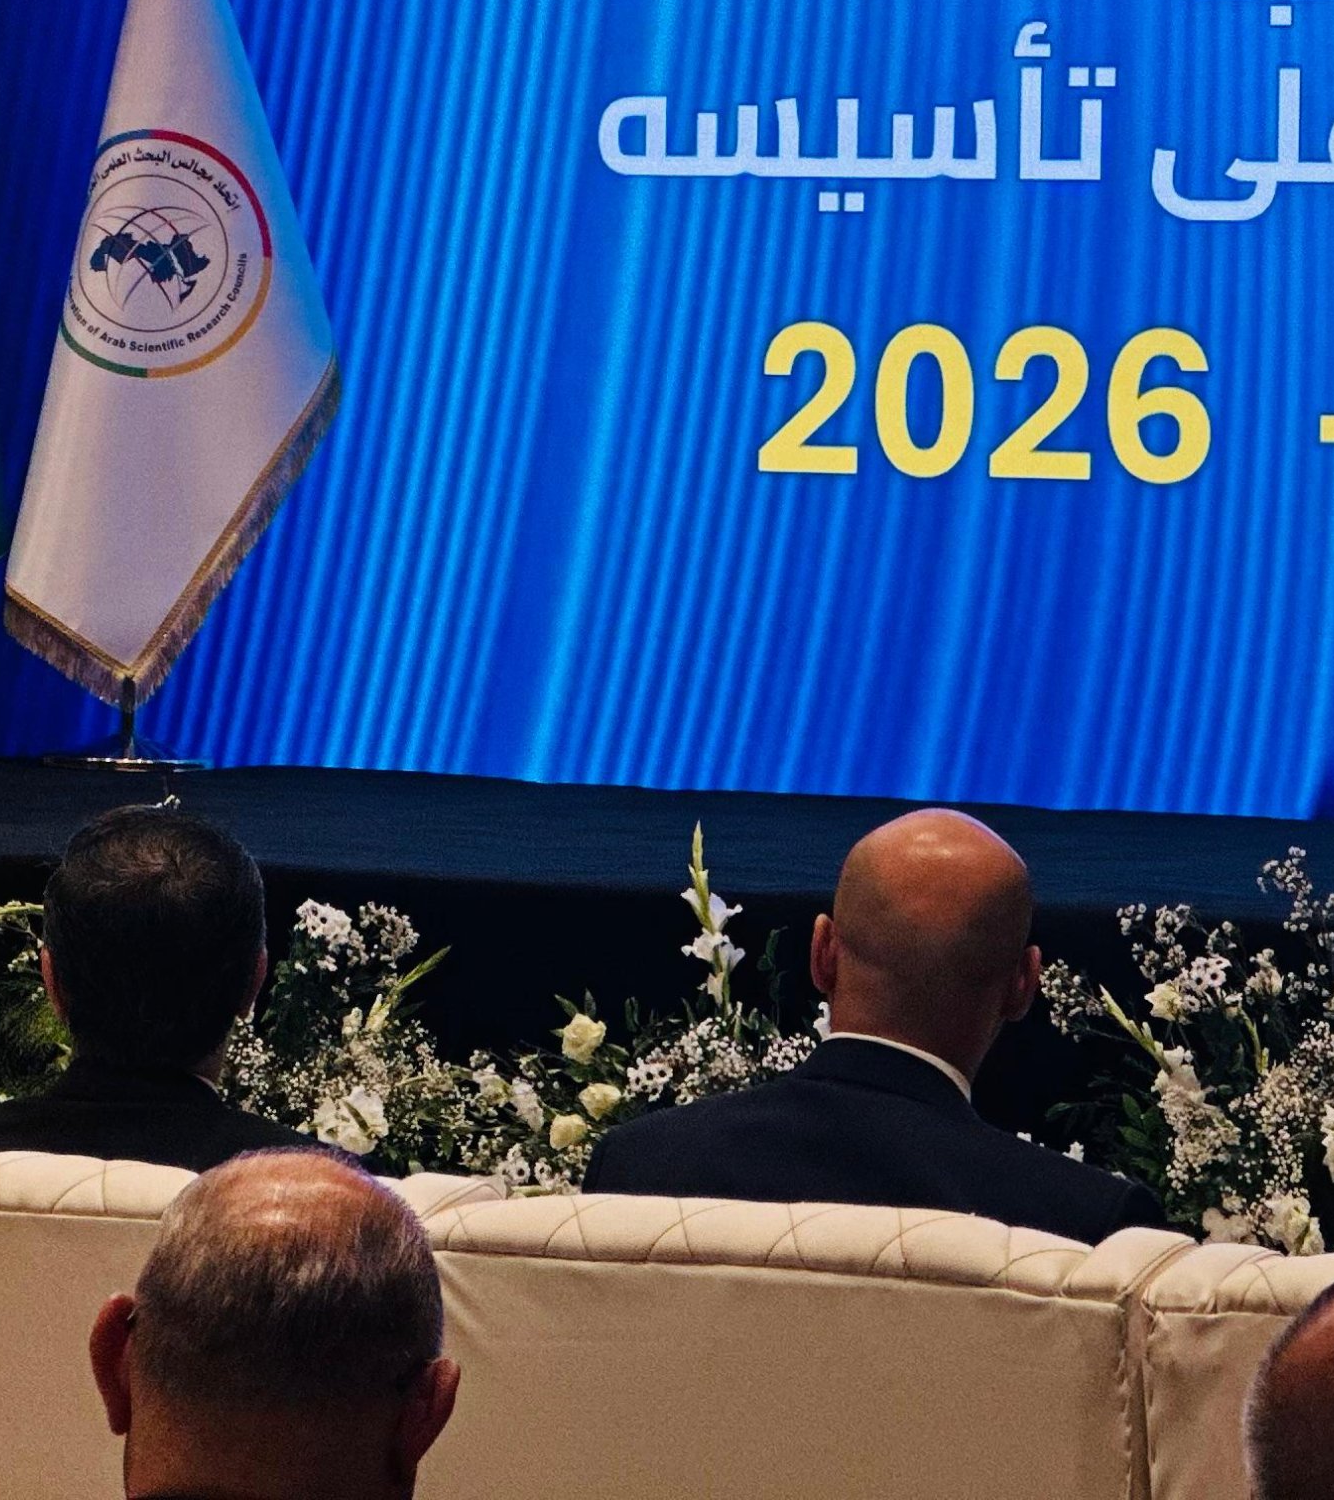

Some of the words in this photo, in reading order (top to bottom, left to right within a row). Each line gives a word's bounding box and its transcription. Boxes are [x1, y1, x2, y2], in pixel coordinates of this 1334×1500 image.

[598, 21, 1117, 213] تأسيسه
[133, 146, 171, 167] البحث
[171, 158, 213, 182] مجالس
[213, 181, 241, 211] اتحاد
[87, 325, 100, 335] of
[99, 331, 126, 349] Arab
[128, 338, 186, 353] Scientific
[186, 303, 231, 344] Research
[227, 252, 248, 303] Councils
[756, 319, 1213, 486] 2026
